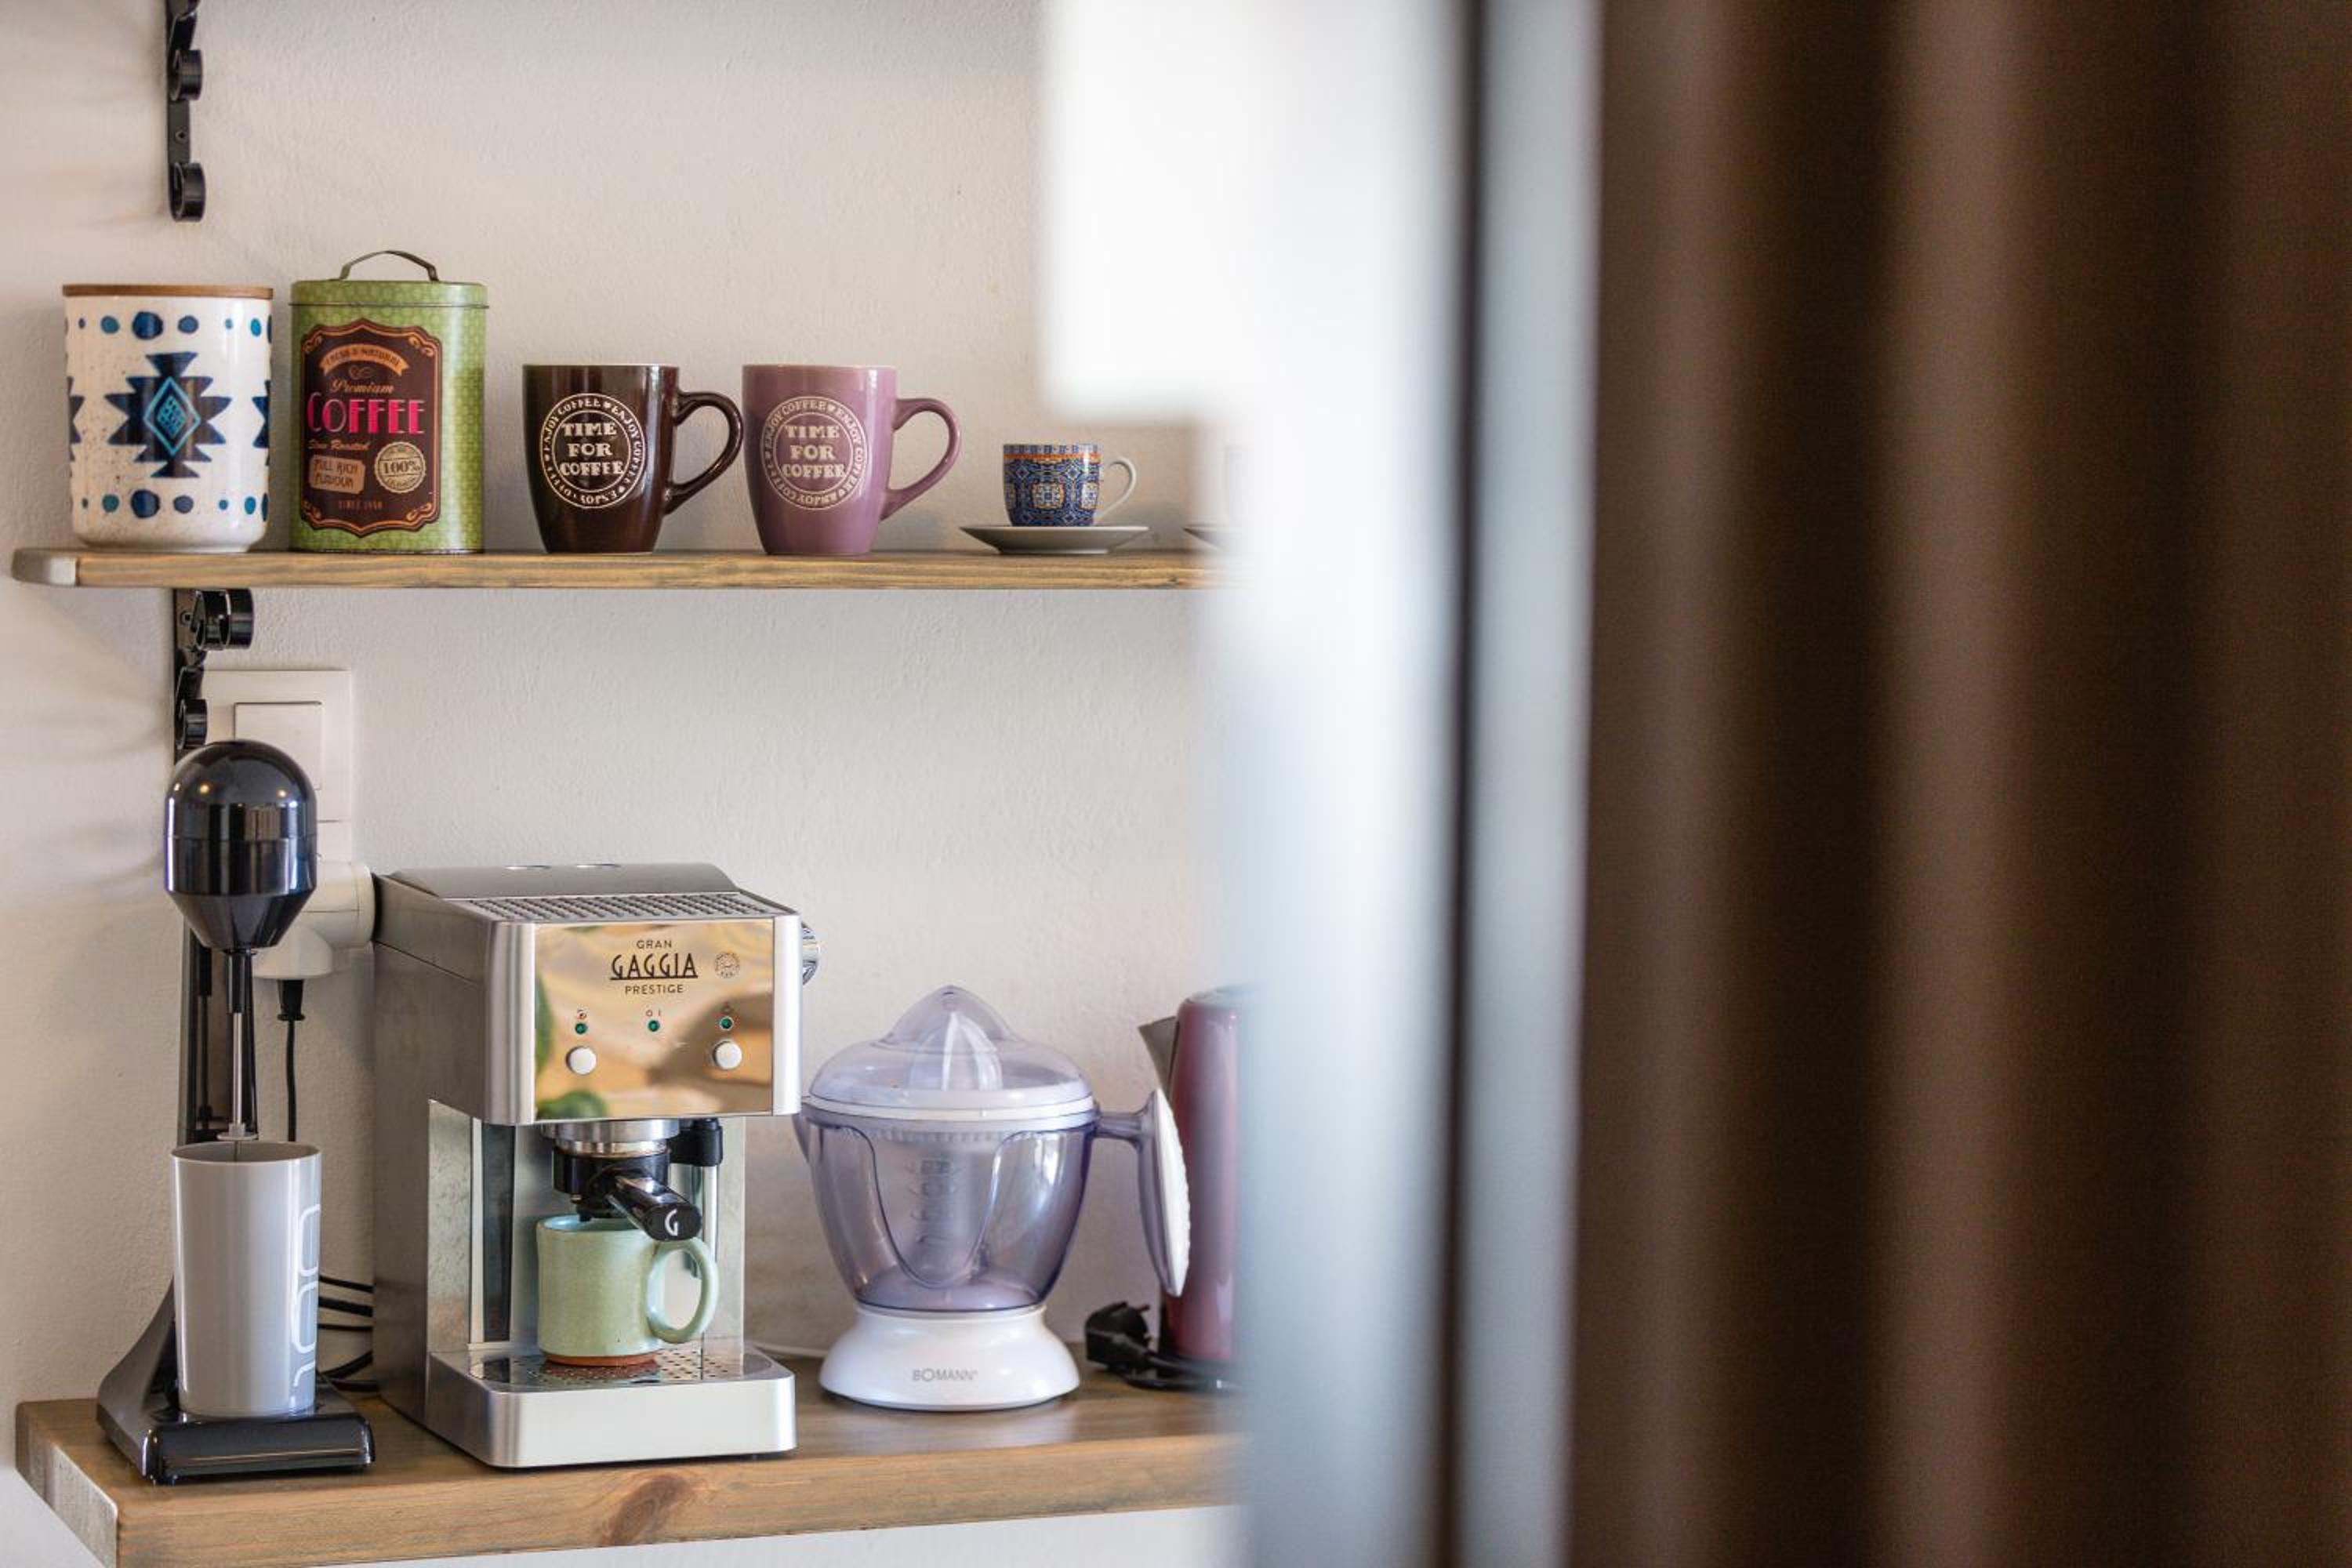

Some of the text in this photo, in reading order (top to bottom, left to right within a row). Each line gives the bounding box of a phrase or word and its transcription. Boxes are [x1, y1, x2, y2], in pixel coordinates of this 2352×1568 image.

[782, 400, 827, 415] COFFEE
[836, 408, 862, 445] ENJOY
[561, 423, 618, 437] TIME
[785, 425, 840, 438] TIME
[567, 443, 613, 457] FOR
[789, 445, 837, 459] FOR
[383, 460, 421, 474] 100%
[559, 461, 625, 476] COFFEE
[782, 463, 846, 478] COFFEE
[636, 940, 673, 949] GRAN
[611, 953, 697, 978] GAGGIA
[625, 984, 684, 995] PRESTIGE
[664, 1208, 678, 1236] G
